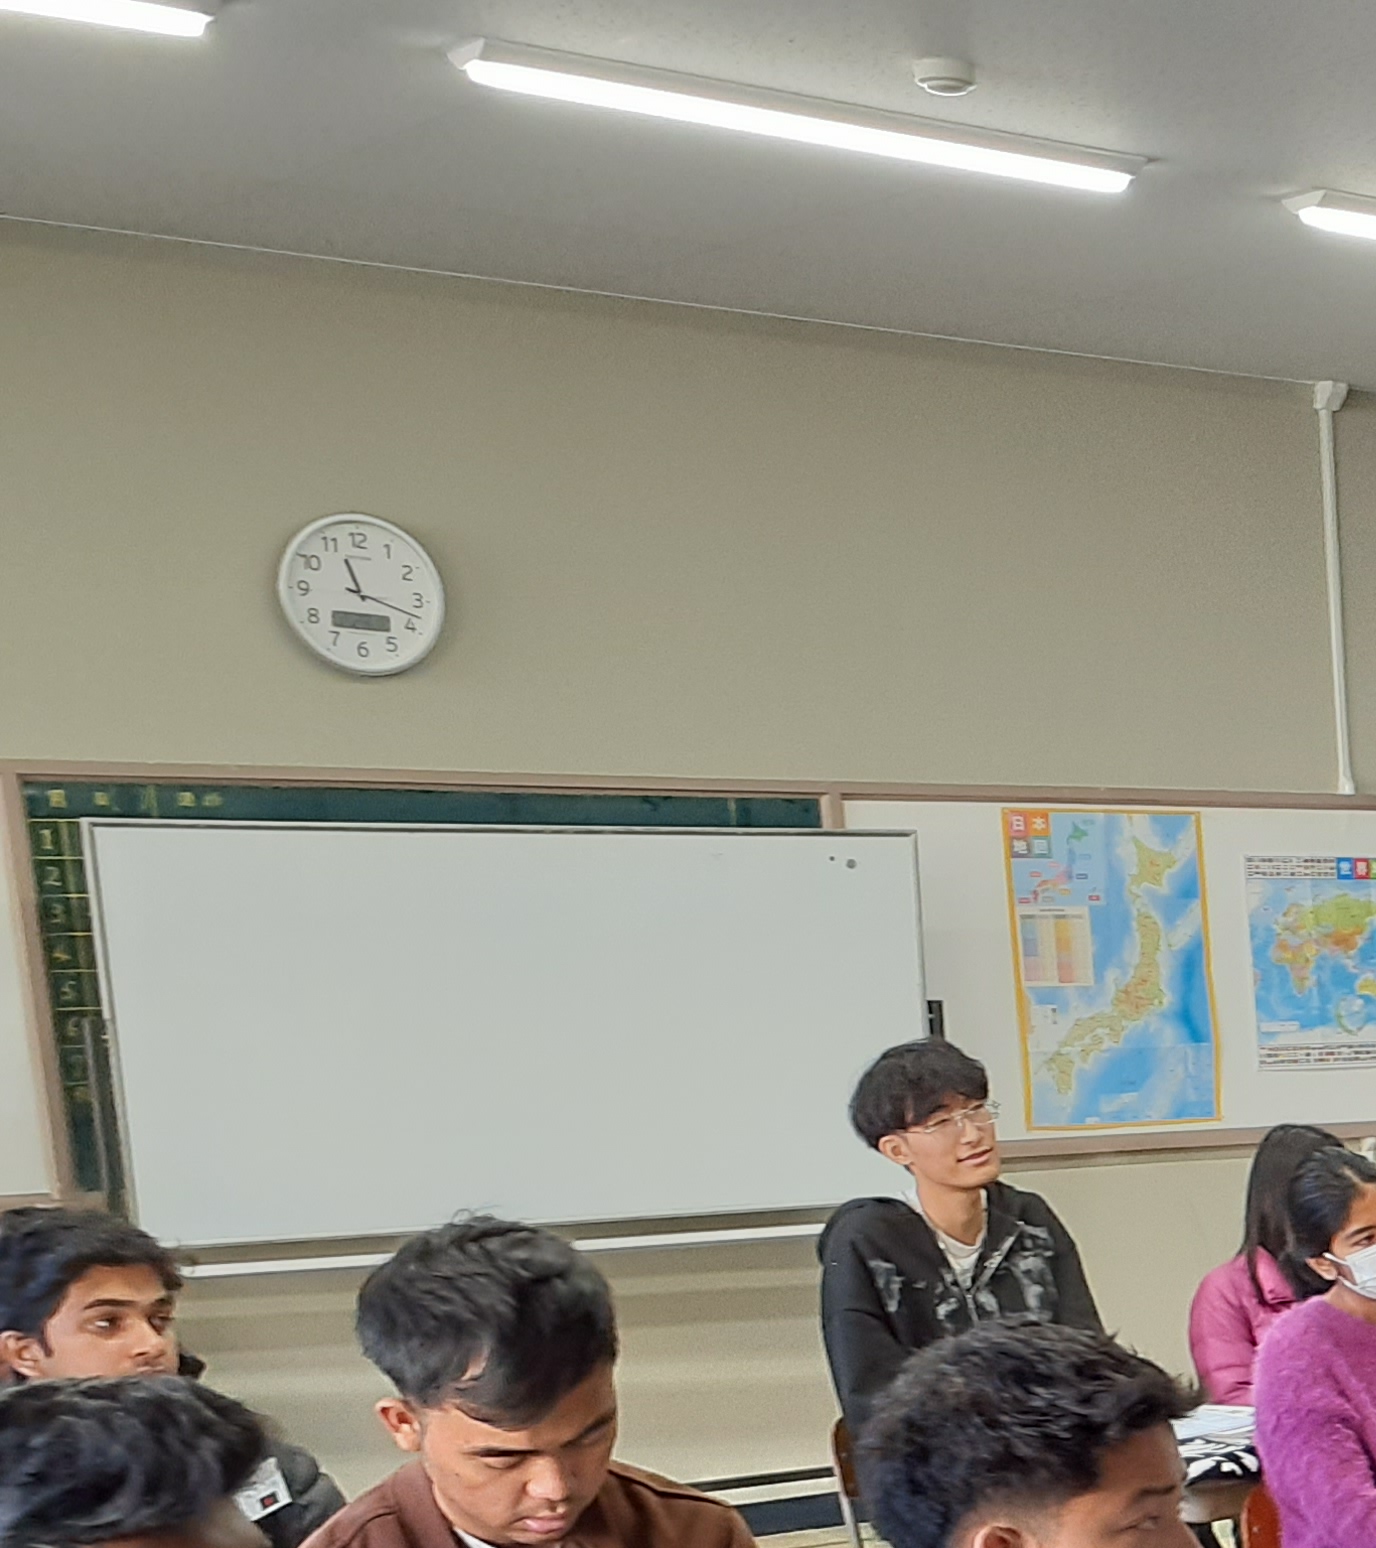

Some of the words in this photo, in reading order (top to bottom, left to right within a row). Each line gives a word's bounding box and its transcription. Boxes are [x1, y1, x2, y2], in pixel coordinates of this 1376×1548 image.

[321, 536, 339, 553] 11
[348, 532, 368, 550] 12
[301, 553, 321, 571] 10
[401, 565, 414, 581] 2
[297, 580, 310, 596] 9
[412, 592, 424, 609] 3
[307, 608, 320, 624] 8
[404, 617, 417, 633] 4
[328, 631, 340, 647] 7
[385, 637, 399, 653] 5
[357, 641, 369, 657] 6
